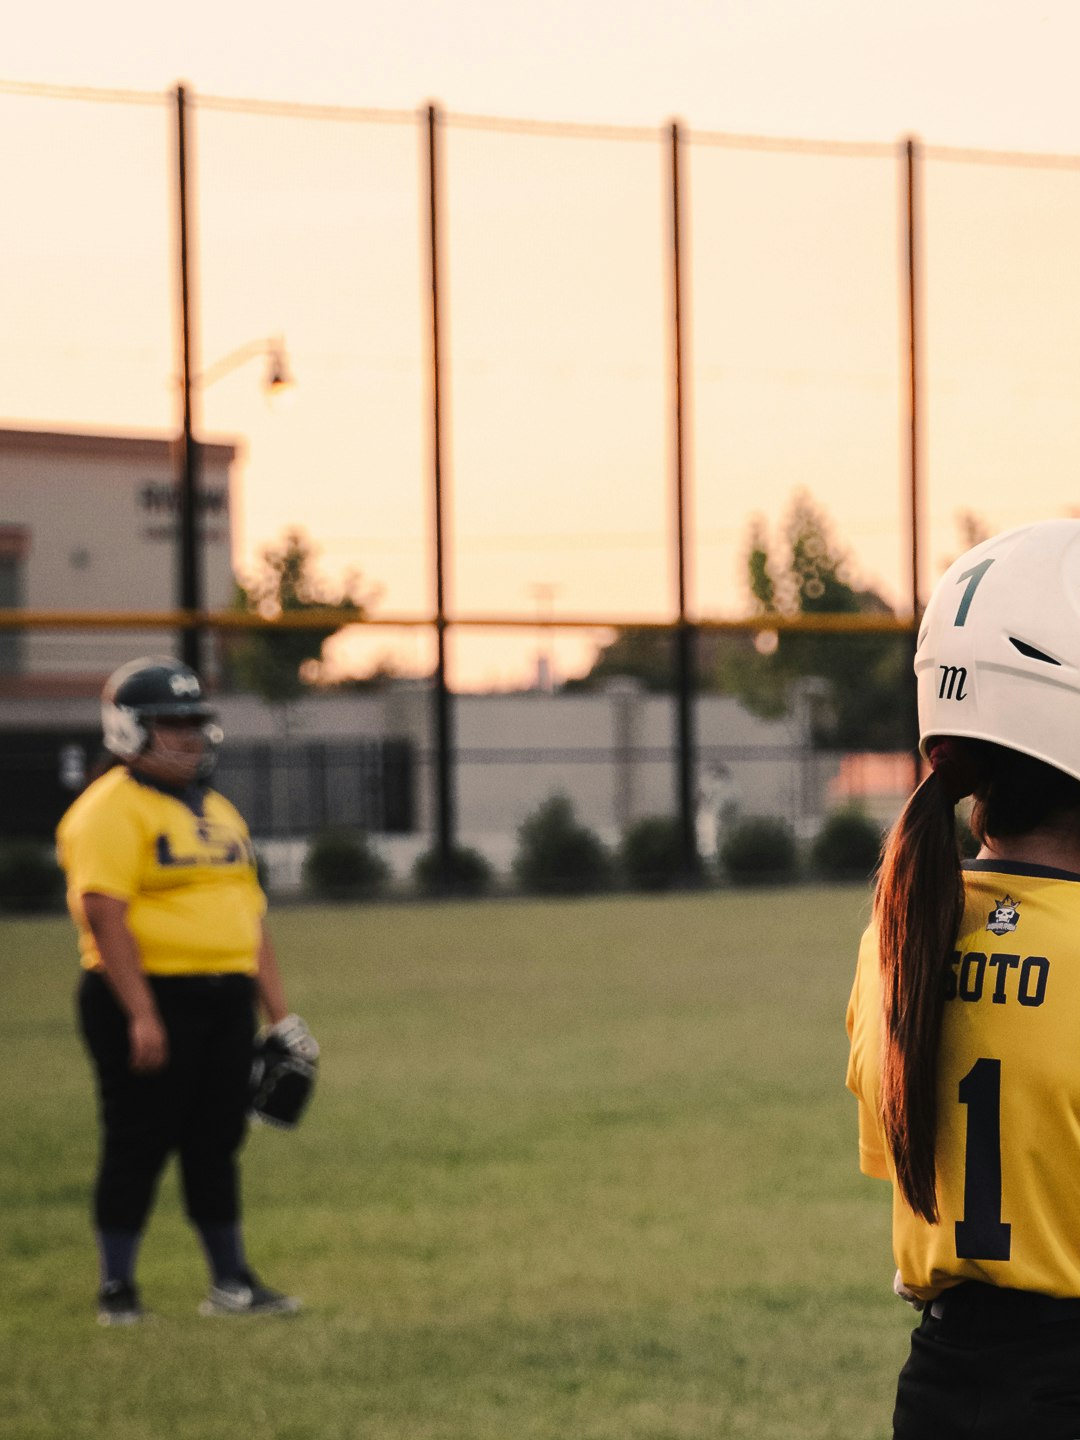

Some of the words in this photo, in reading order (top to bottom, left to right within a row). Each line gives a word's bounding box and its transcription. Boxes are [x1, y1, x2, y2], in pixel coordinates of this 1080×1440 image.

[954, 558, 995, 627] 1
[943, 951, 1050, 1007] SOTO
[955, 1058, 1011, 1261] 1
